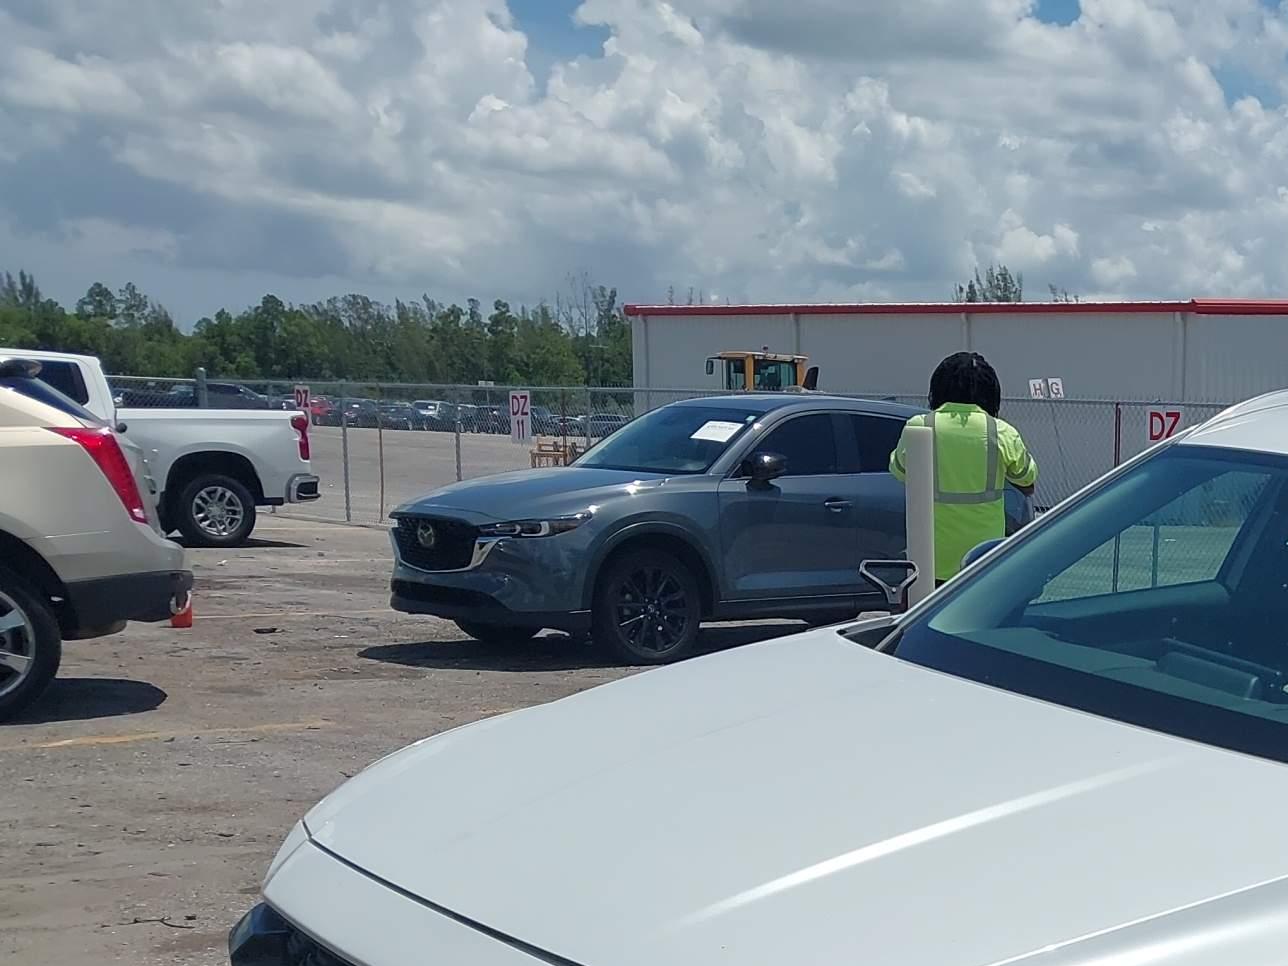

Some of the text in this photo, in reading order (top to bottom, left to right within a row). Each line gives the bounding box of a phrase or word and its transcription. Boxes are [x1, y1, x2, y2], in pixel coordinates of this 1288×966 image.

[1033, 383, 1044, 396] H
[1050, 382, 1061, 395] G
[295, 389, 309, 408] DZ
[511, 395, 529, 416] DZ
[516, 420, 525, 440] 11
[1150, 412, 1181, 441] DZ
